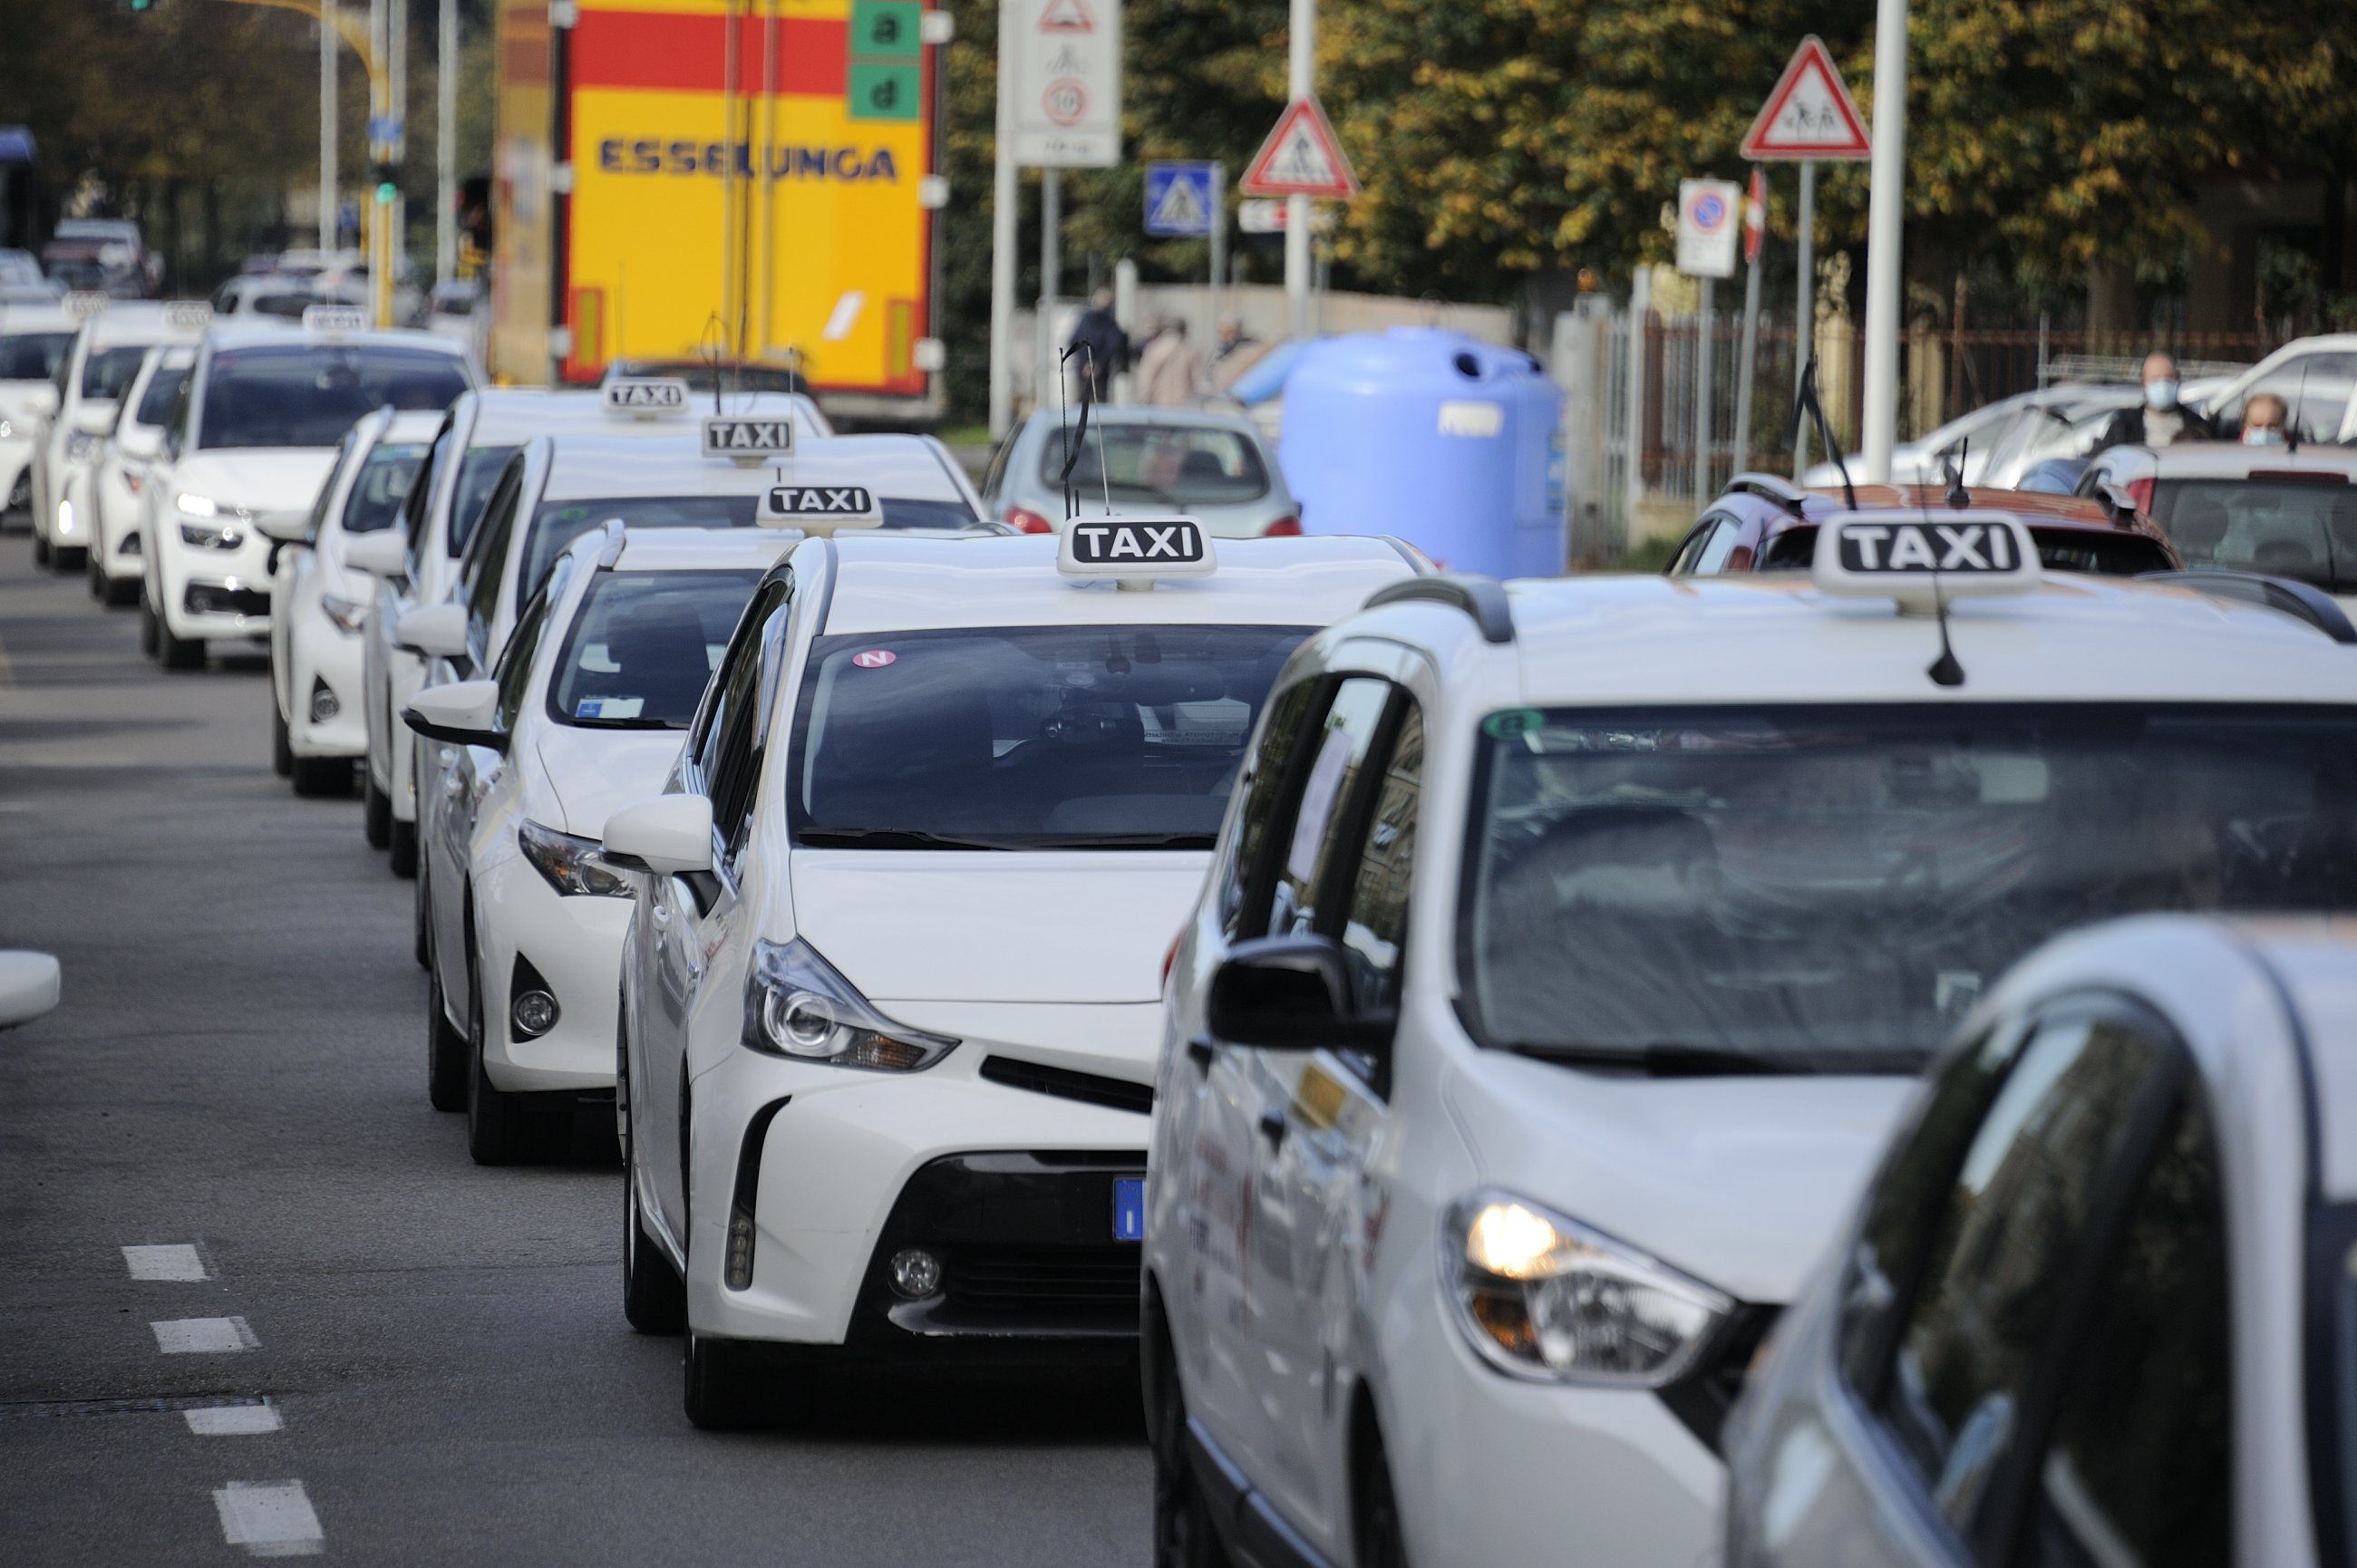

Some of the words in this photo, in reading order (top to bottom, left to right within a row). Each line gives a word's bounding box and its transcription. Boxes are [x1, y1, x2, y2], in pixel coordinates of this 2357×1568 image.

[871, 78, 897, 110] d
[600, 139, 897, 179] ESSELUNGA
[616, 385, 680, 405] TAXI
[710, 424, 788, 448] TAXI
[772, 489, 864, 510] TAXI
[1077, 527, 1194, 557] TAXI
[1841, 525, 2012, 570] TAXI
[861, 652, 887, 666] N
[1126, 1210, 1132, 1234] I
